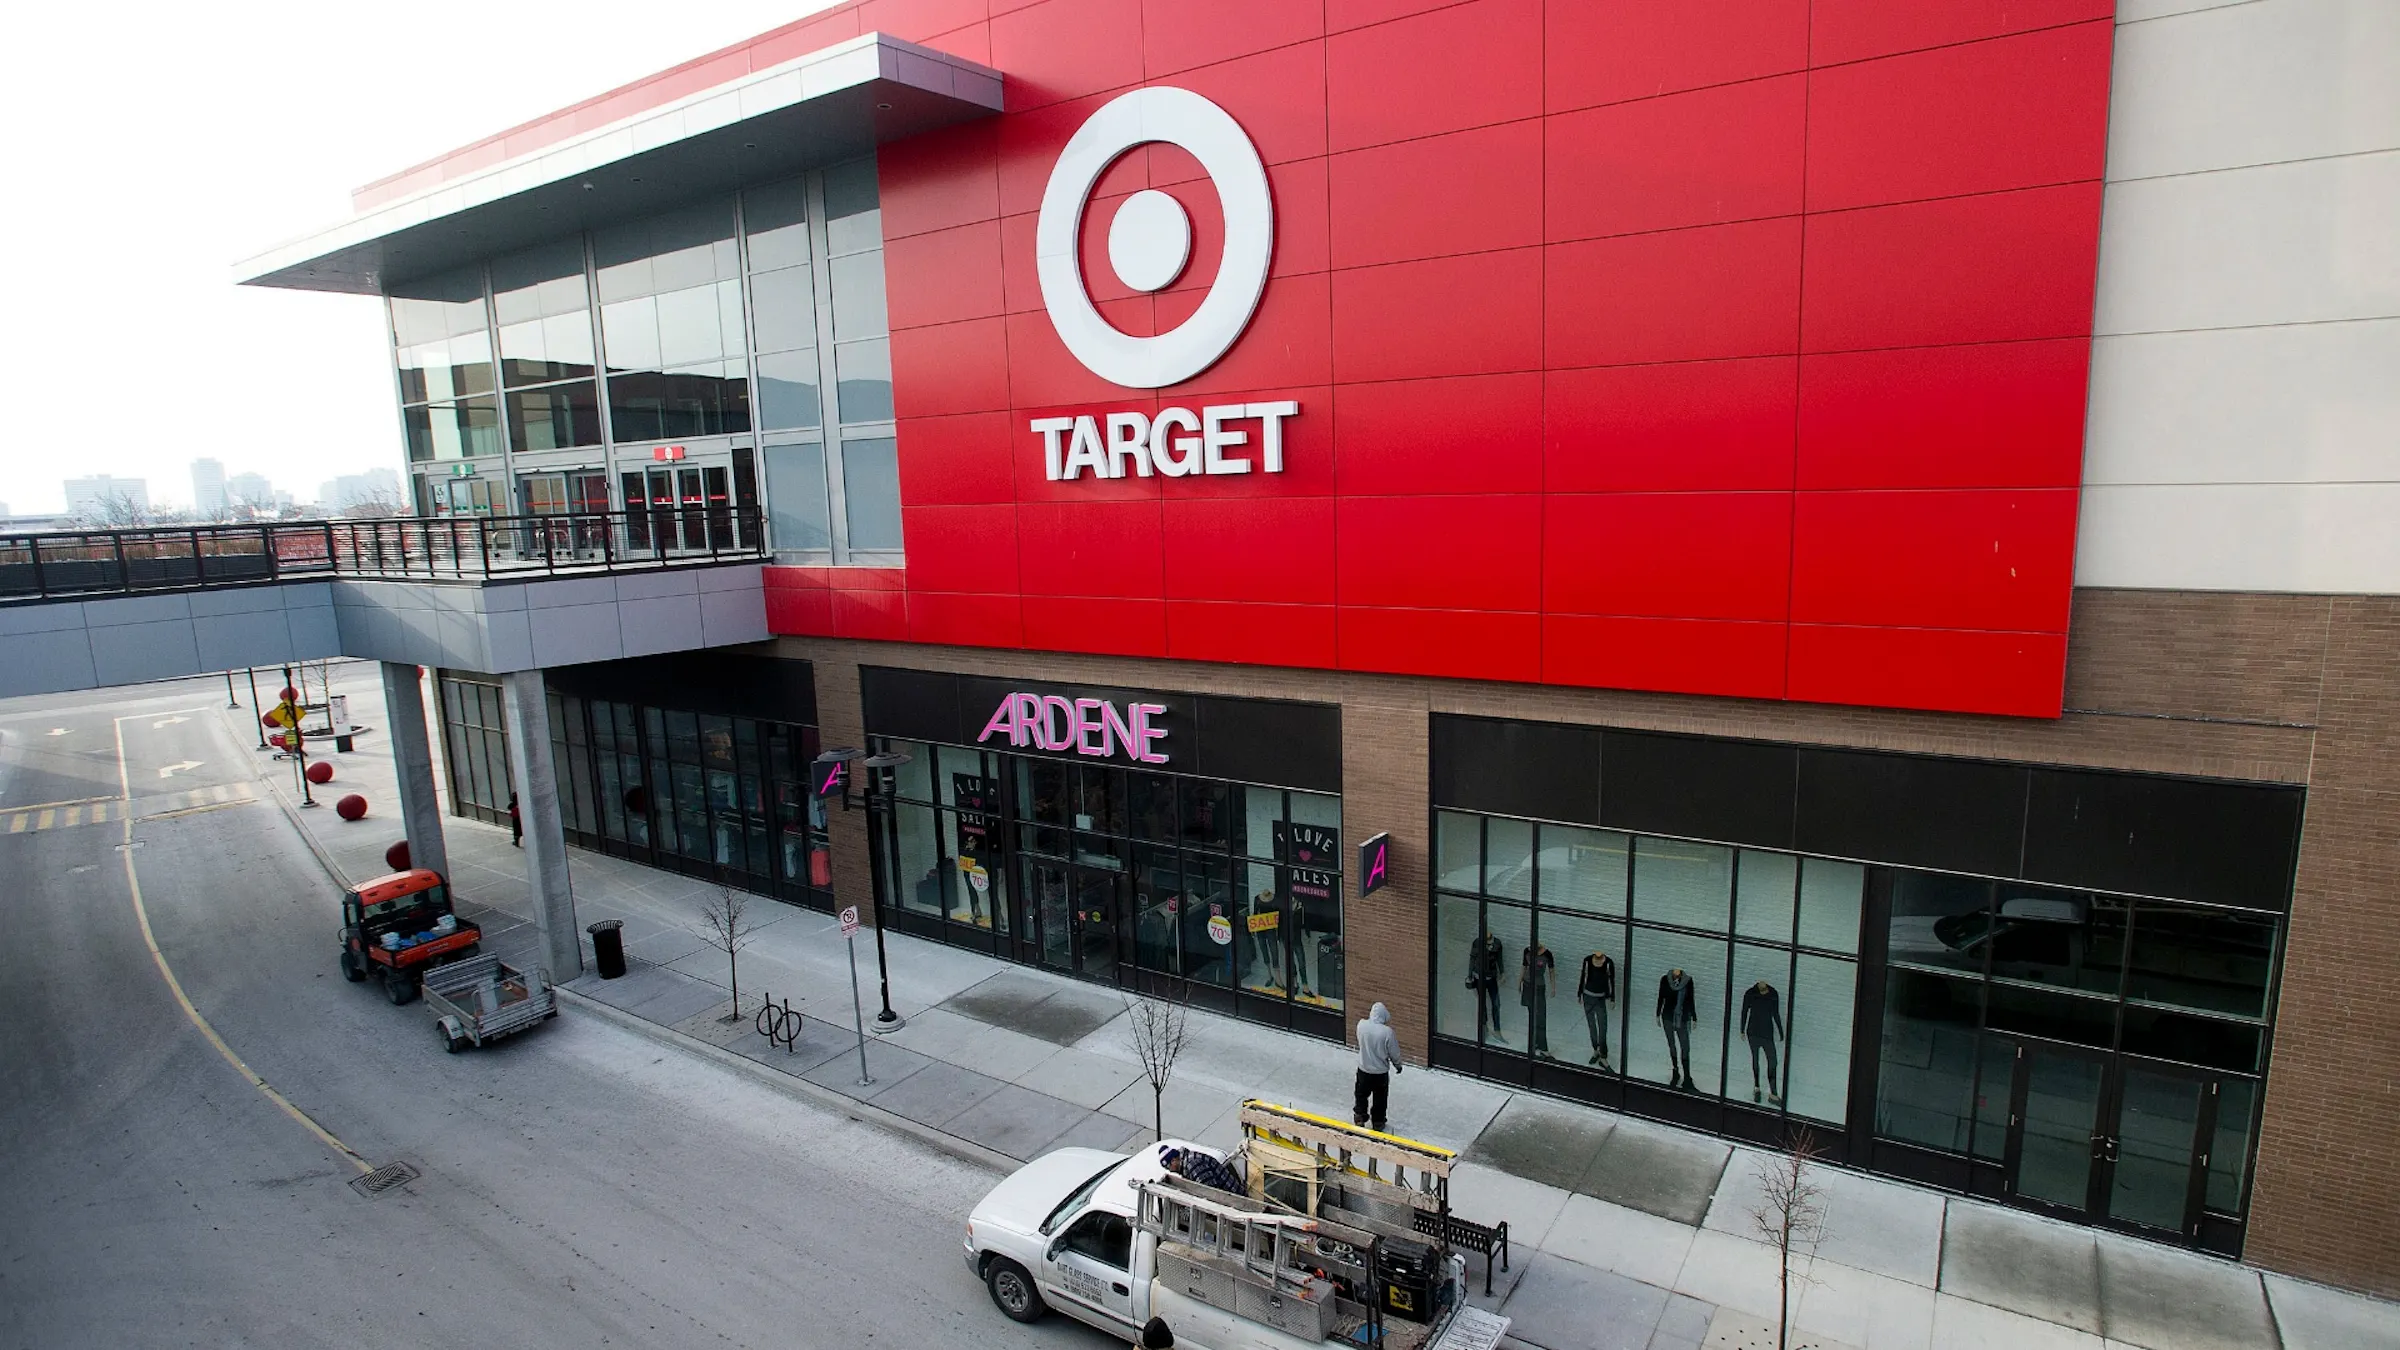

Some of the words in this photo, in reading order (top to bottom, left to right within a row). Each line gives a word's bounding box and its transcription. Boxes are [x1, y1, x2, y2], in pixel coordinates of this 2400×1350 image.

[1030, 400, 1298, 480] TARGET
[977, 692, 1169, 764] ARDENE
[1293, 827, 1334, 853] LOVE
[1292, 869, 1330, 886] ALES
[1367, 843, 1385, 888] A
